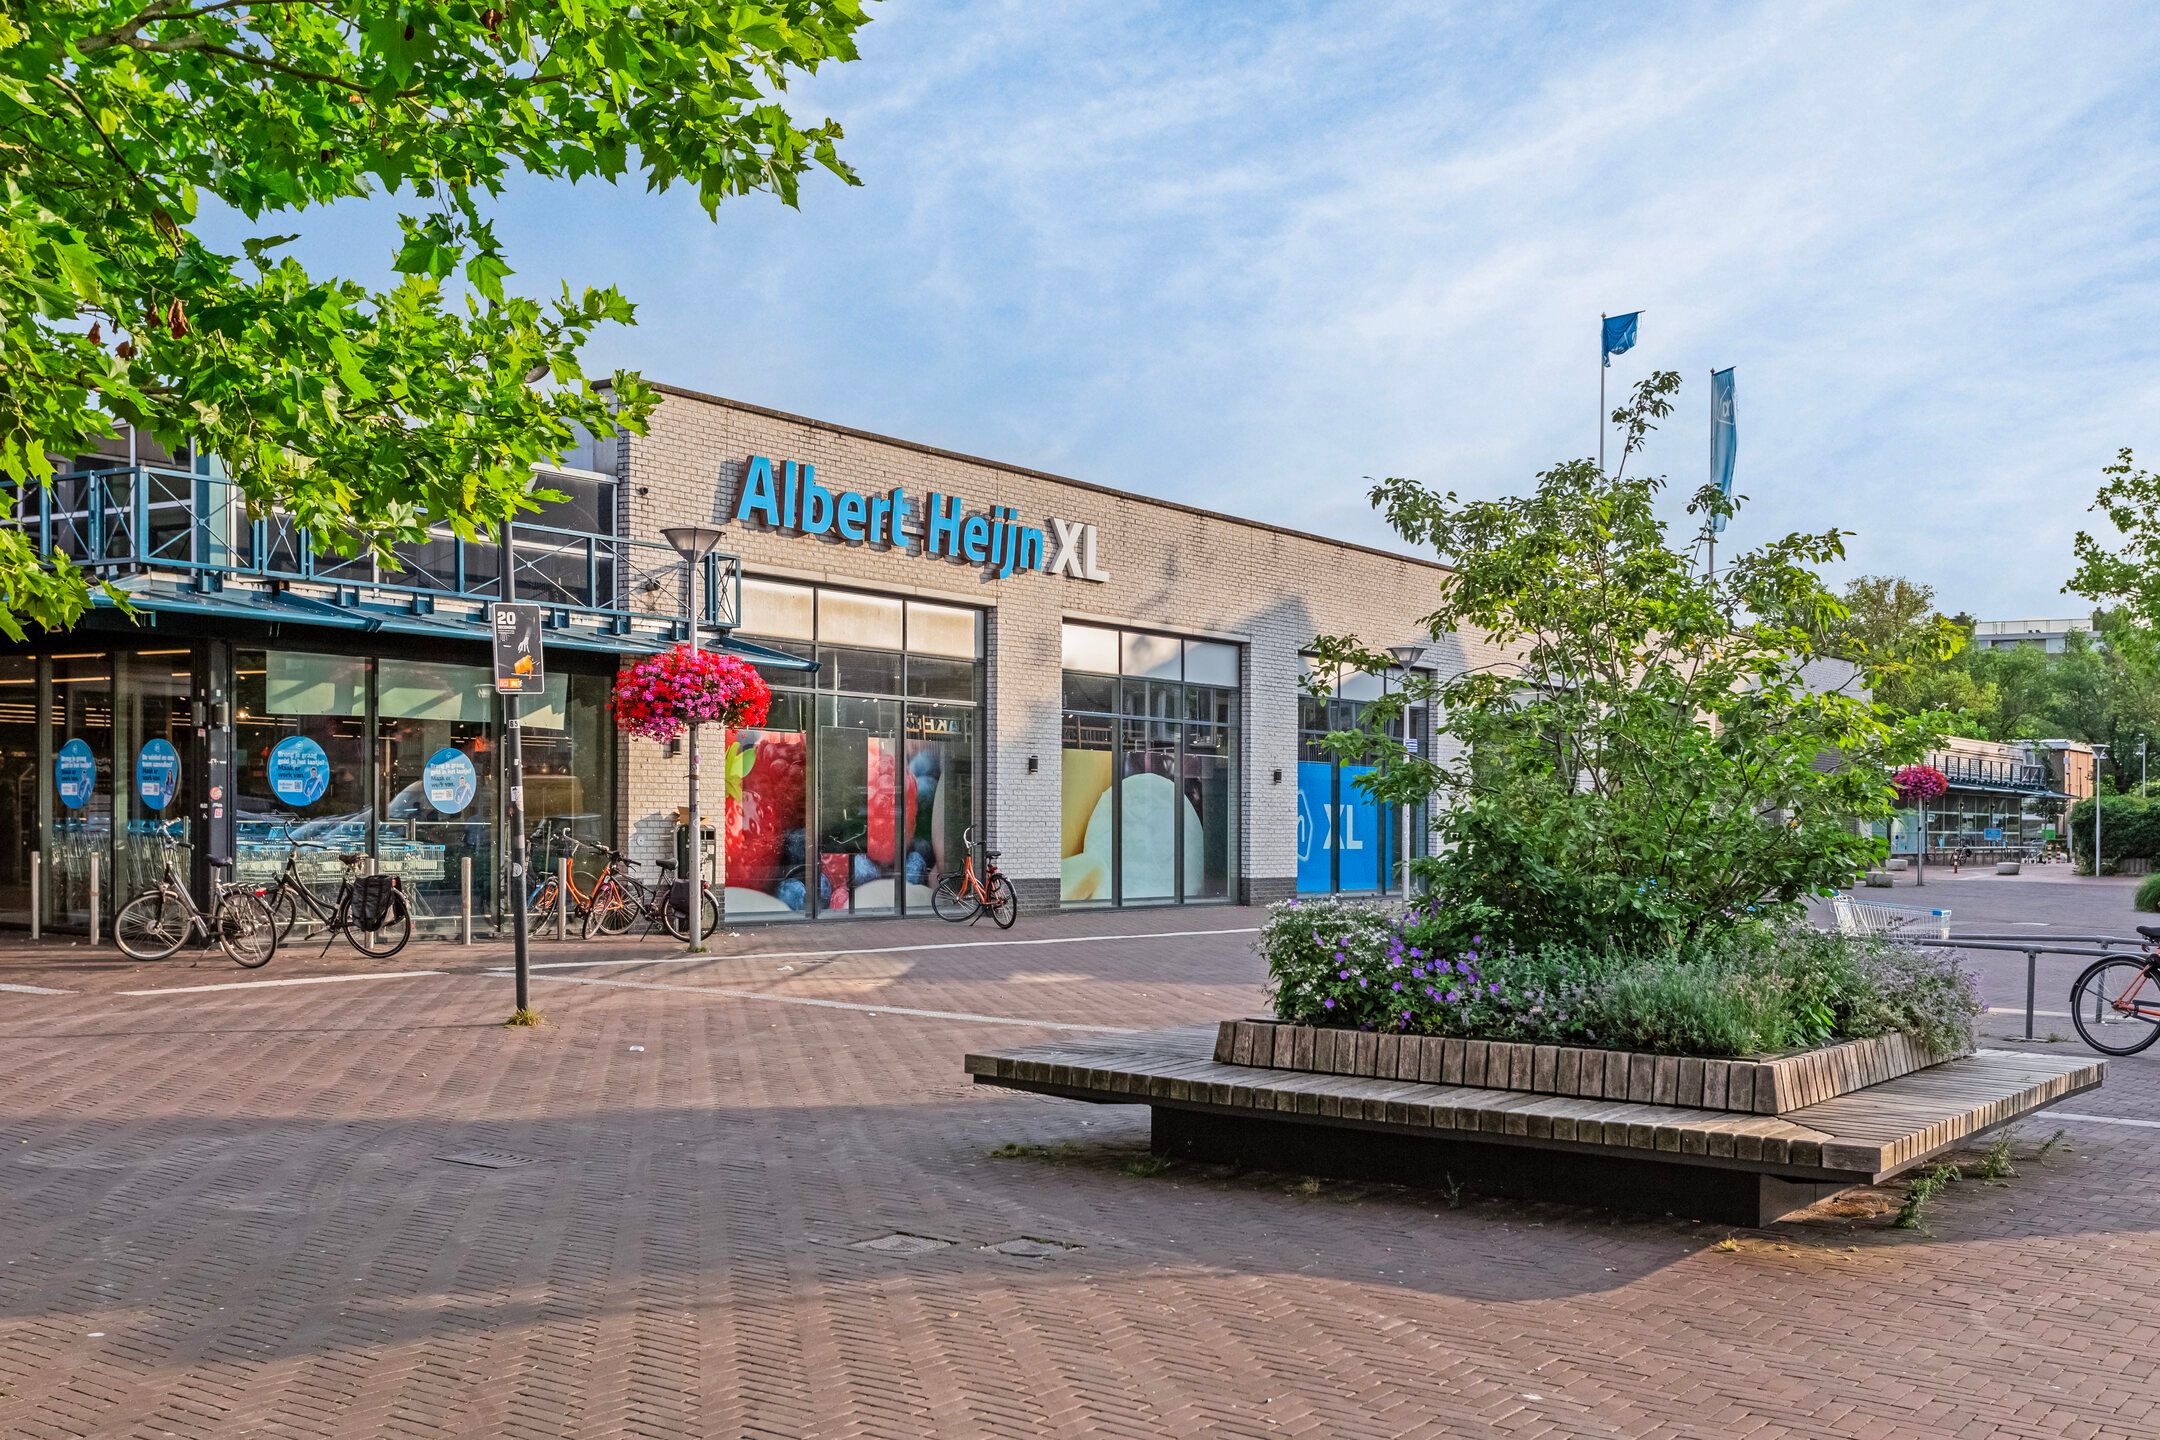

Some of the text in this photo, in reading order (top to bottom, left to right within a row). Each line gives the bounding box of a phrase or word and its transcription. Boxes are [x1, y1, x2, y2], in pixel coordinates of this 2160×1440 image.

[734, 455, 1110, 582] Albert Heijn XL
[497, 611, 516, 625] 20
[1323, 803, 1363, 850] XL
